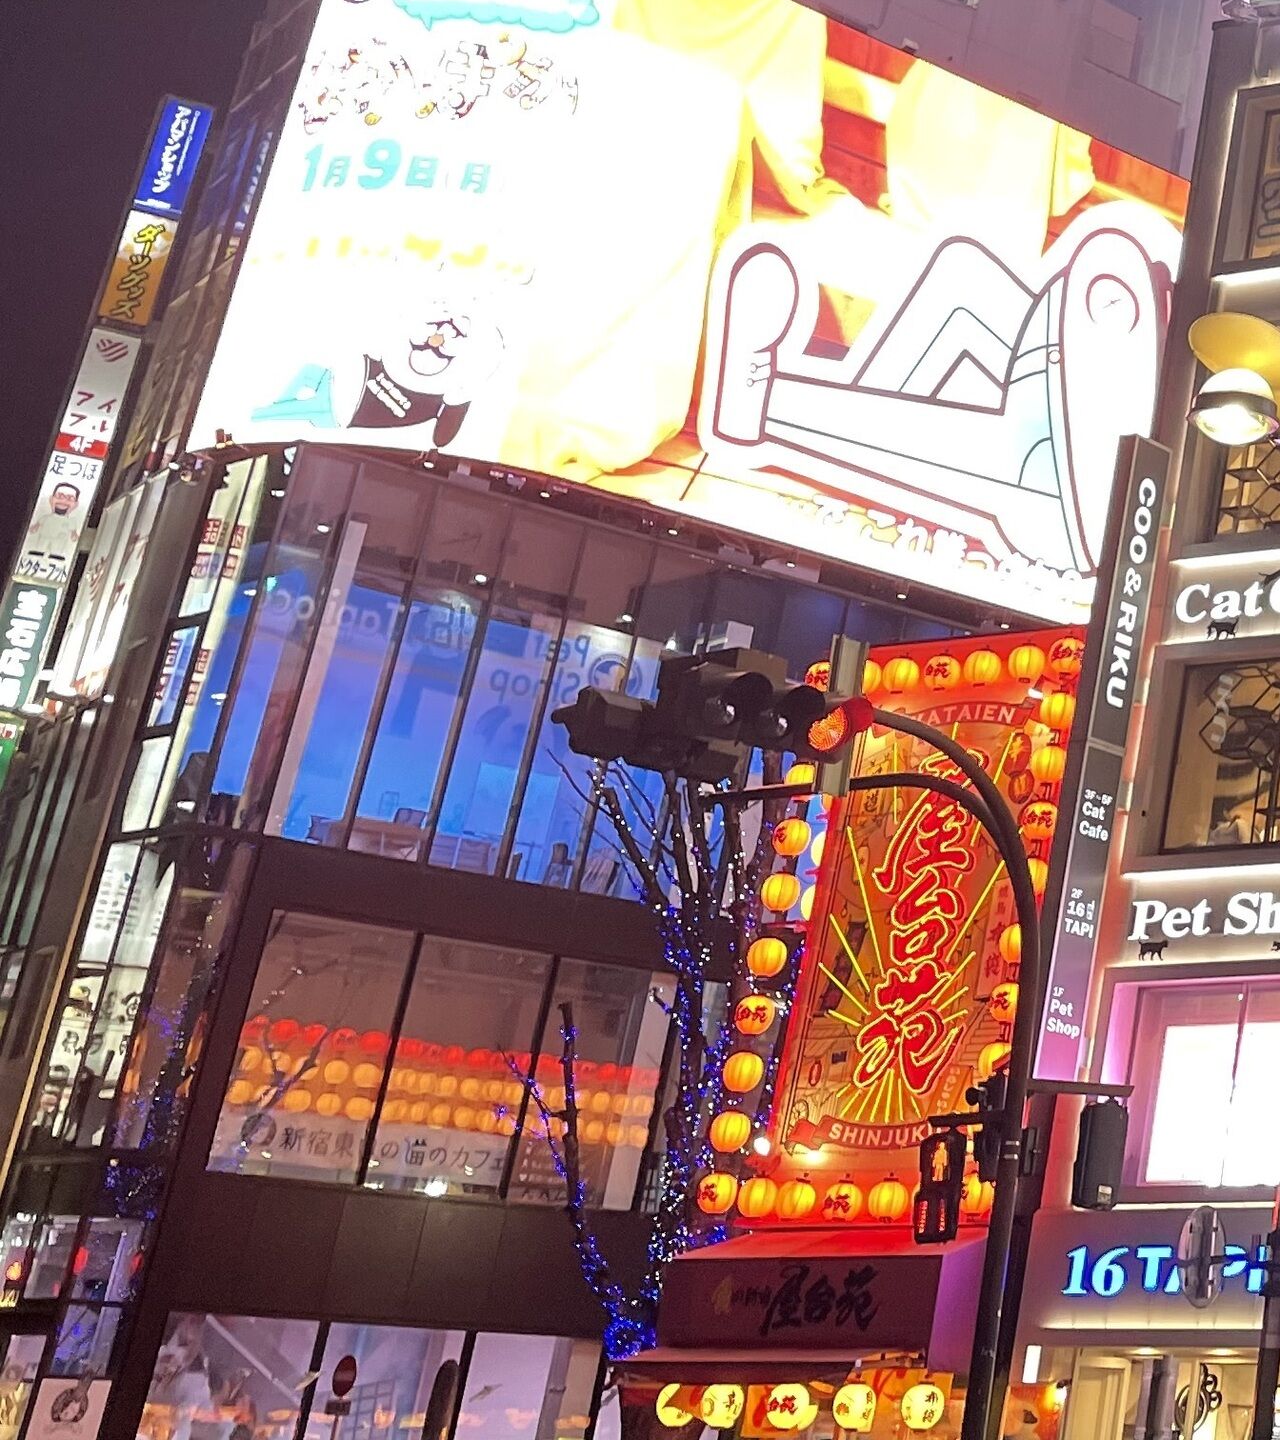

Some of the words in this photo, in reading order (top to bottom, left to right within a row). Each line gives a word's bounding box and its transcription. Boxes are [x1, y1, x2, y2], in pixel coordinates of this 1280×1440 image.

[69, 436, 97, 454] 4F
[1128, 476, 1157, 566] COO
[1122, 566, 1143, 595] &
[1175, 582, 1264, 624] Cat
[1103, 603, 1141, 710] RIKU
[1081, 800, 1106, 822] Cat
[1078, 819, 1110, 843] Cafe
[1070, 887, 1084, 900] 2F
[1066, 900, 1085, 918] 16
[1128, 895, 1211, 942] Pet
[1064, 917, 1095, 939] TAPI
[1052, 986, 1065, 998] 1F
[1049, 998, 1074, 1018] Pet
[1046, 1016, 1081, 1039] Shop
[827, 1122, 943, 1146] SHINJUK
[1060, 1244, 1130, 1298] 16
